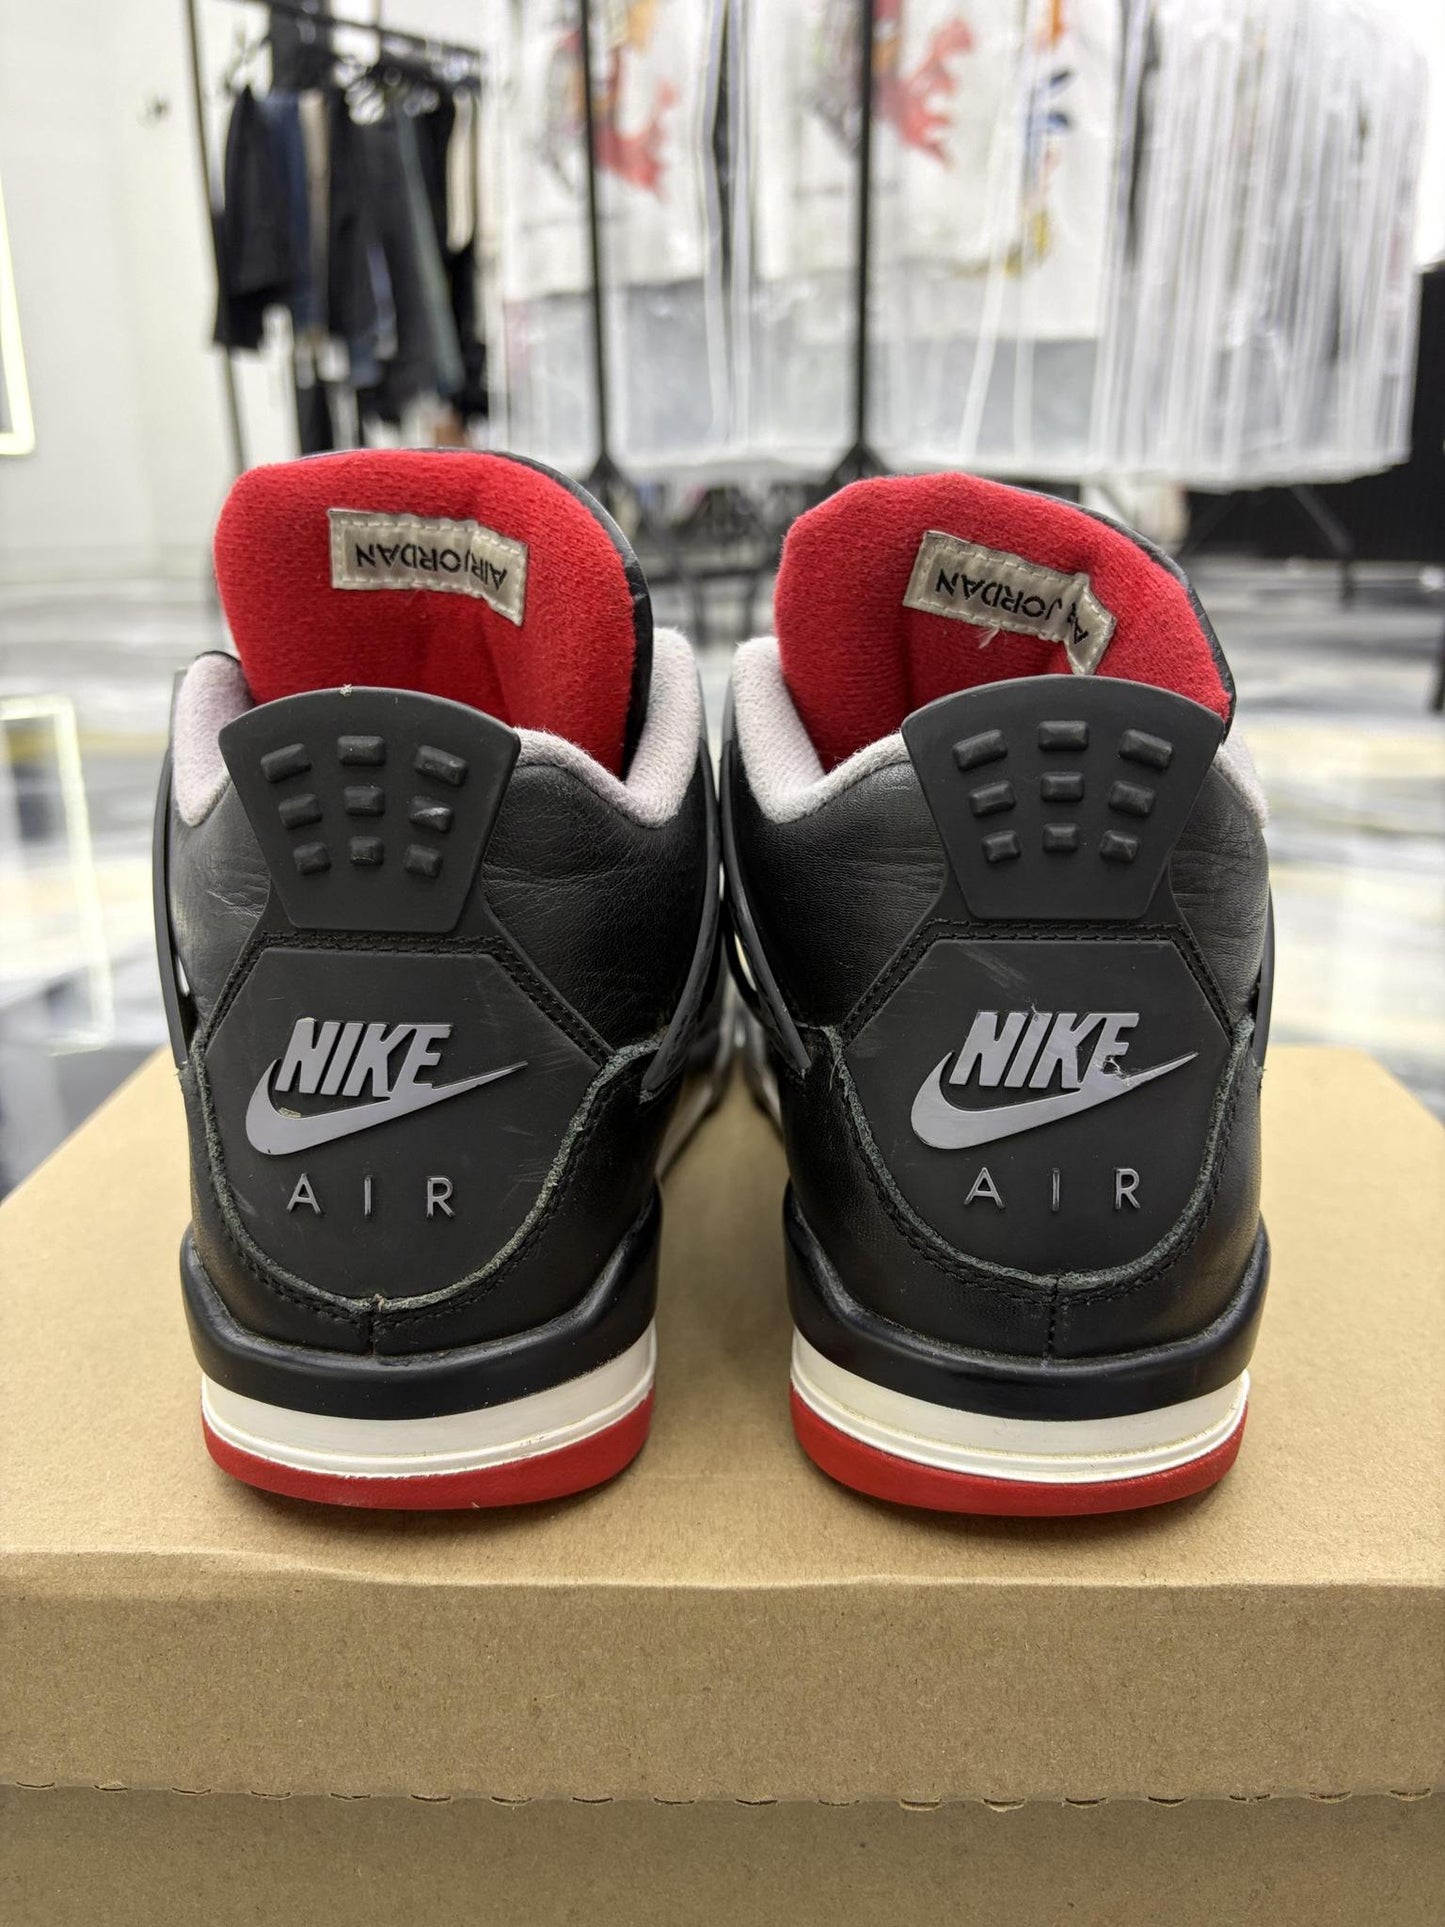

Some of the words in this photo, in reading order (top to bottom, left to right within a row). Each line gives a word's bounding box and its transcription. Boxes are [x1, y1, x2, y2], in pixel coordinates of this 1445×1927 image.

[355, 543, 470, 572] JORDAN
[935, 568, 1063, 621] JORDAN
[275, 1018, 453, 1099] NIKE
[949, 1010, 1140, 1089] NIKE
[286, 1172, 456, 1218] AIR
[963, 1166, 1141, 1211] AIR
